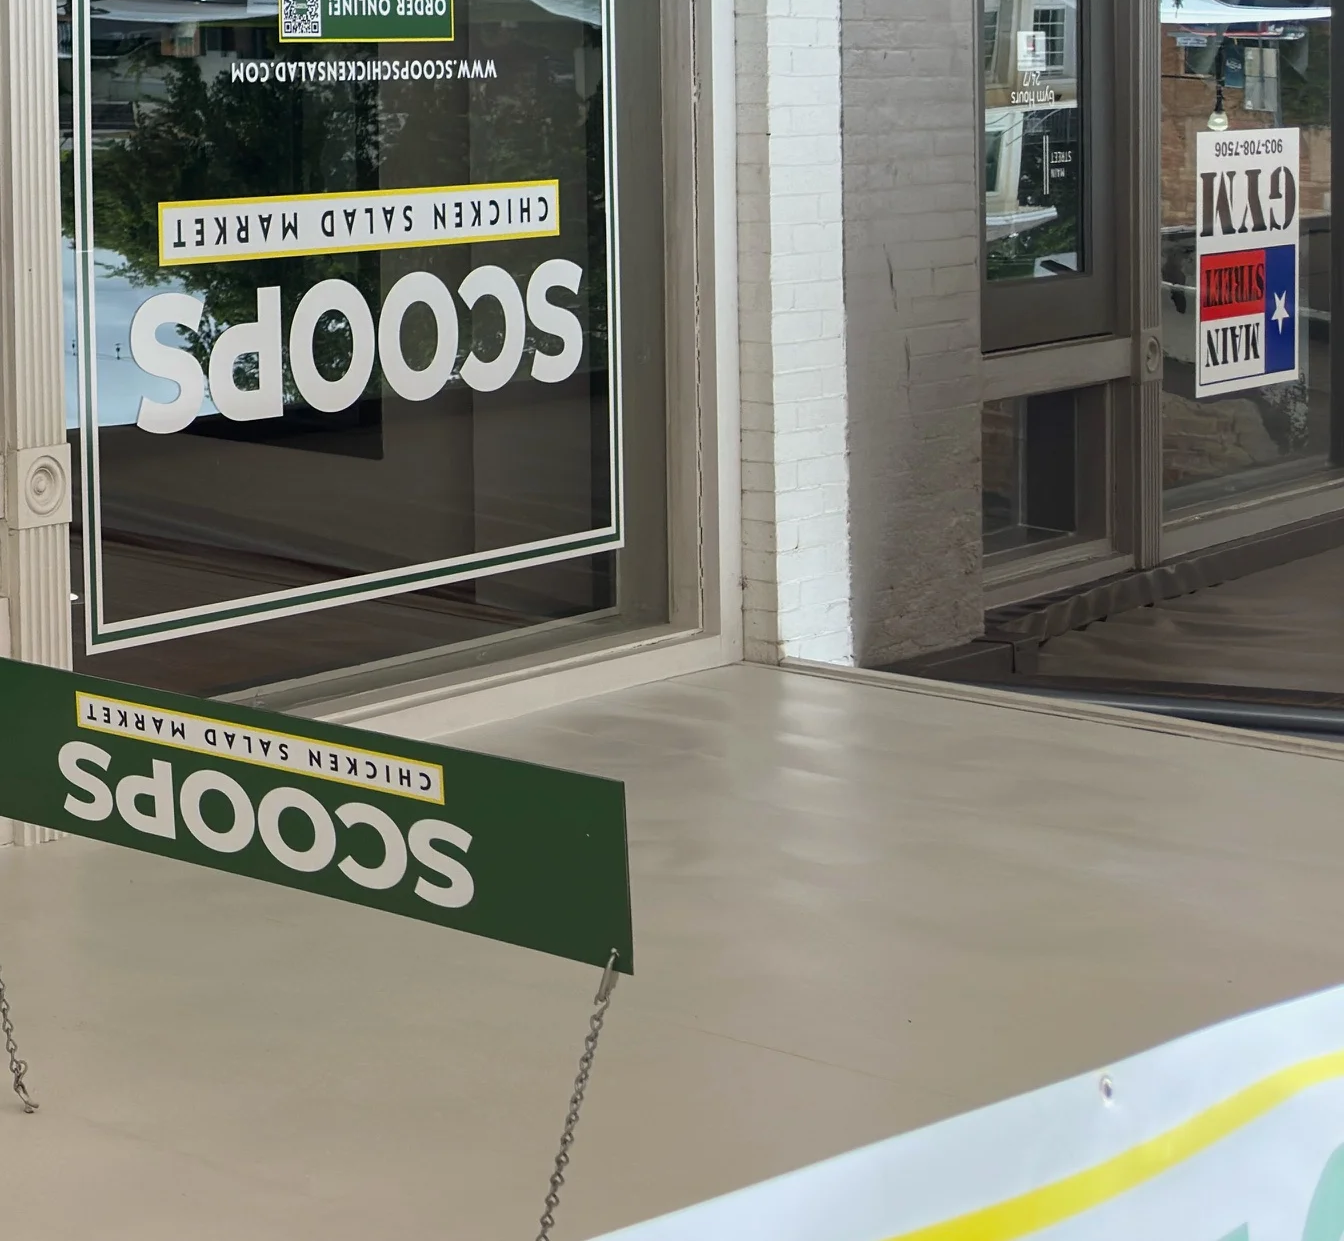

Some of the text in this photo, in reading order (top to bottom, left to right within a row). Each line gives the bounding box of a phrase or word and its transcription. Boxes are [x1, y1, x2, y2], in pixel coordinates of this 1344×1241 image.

[230, 58, 497, 83] WWW.SCOOPSCHICKENSALAD.COM
[1022, 70, 1041, 86] 24/7
[1010, 85, 1055, 109] Gym Hours
[1050, 150, 1072, 164] STREET
[1214, 139, 1283, 157] 903-708-7506
[1050, 167, 1065, 179] MAIN
[171, 195, 549, 249] CHICKEN SALAD MARKET
[1200, 166, 1296, 238] GYM
[1202, 263, 1264, 308] STREET
[129, 258, 584, 434] SCOOPS
[1205, 322, 1260, 368] MAIN
[86, 702, 432, 791] CHICKEN SALAD MARKET
[57, 740, 475, 909] SCOOPS
